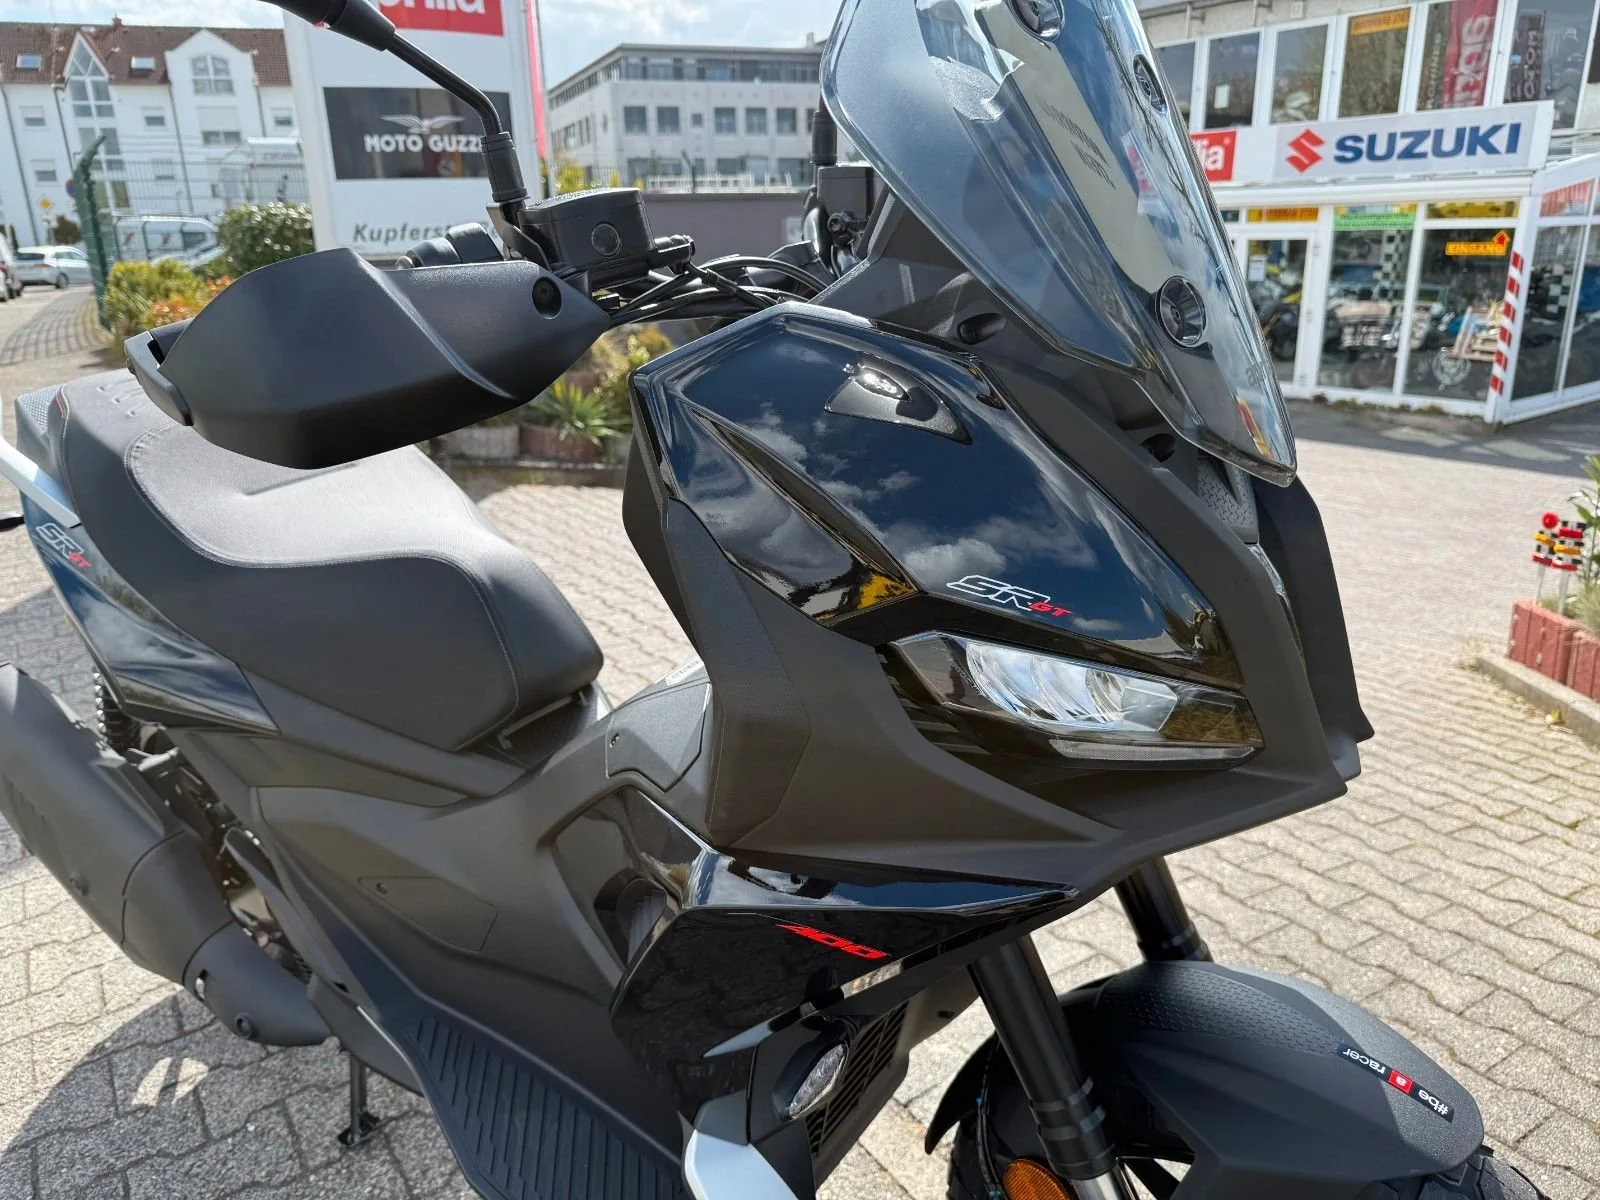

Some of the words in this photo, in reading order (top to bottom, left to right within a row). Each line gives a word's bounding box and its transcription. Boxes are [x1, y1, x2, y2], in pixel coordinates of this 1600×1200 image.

[364, 134, 424, 153] MOTO
[1333, 122, 1522, 165] SUZUKI
[1029, 602, 1072, 617] GT
[776, 924, 888, 959] 400
[1342, 1048, 1386, 1074] racer
[1395, 1075, 1407, 1087] a
[1418, 1089, 1449, 1116] #be
